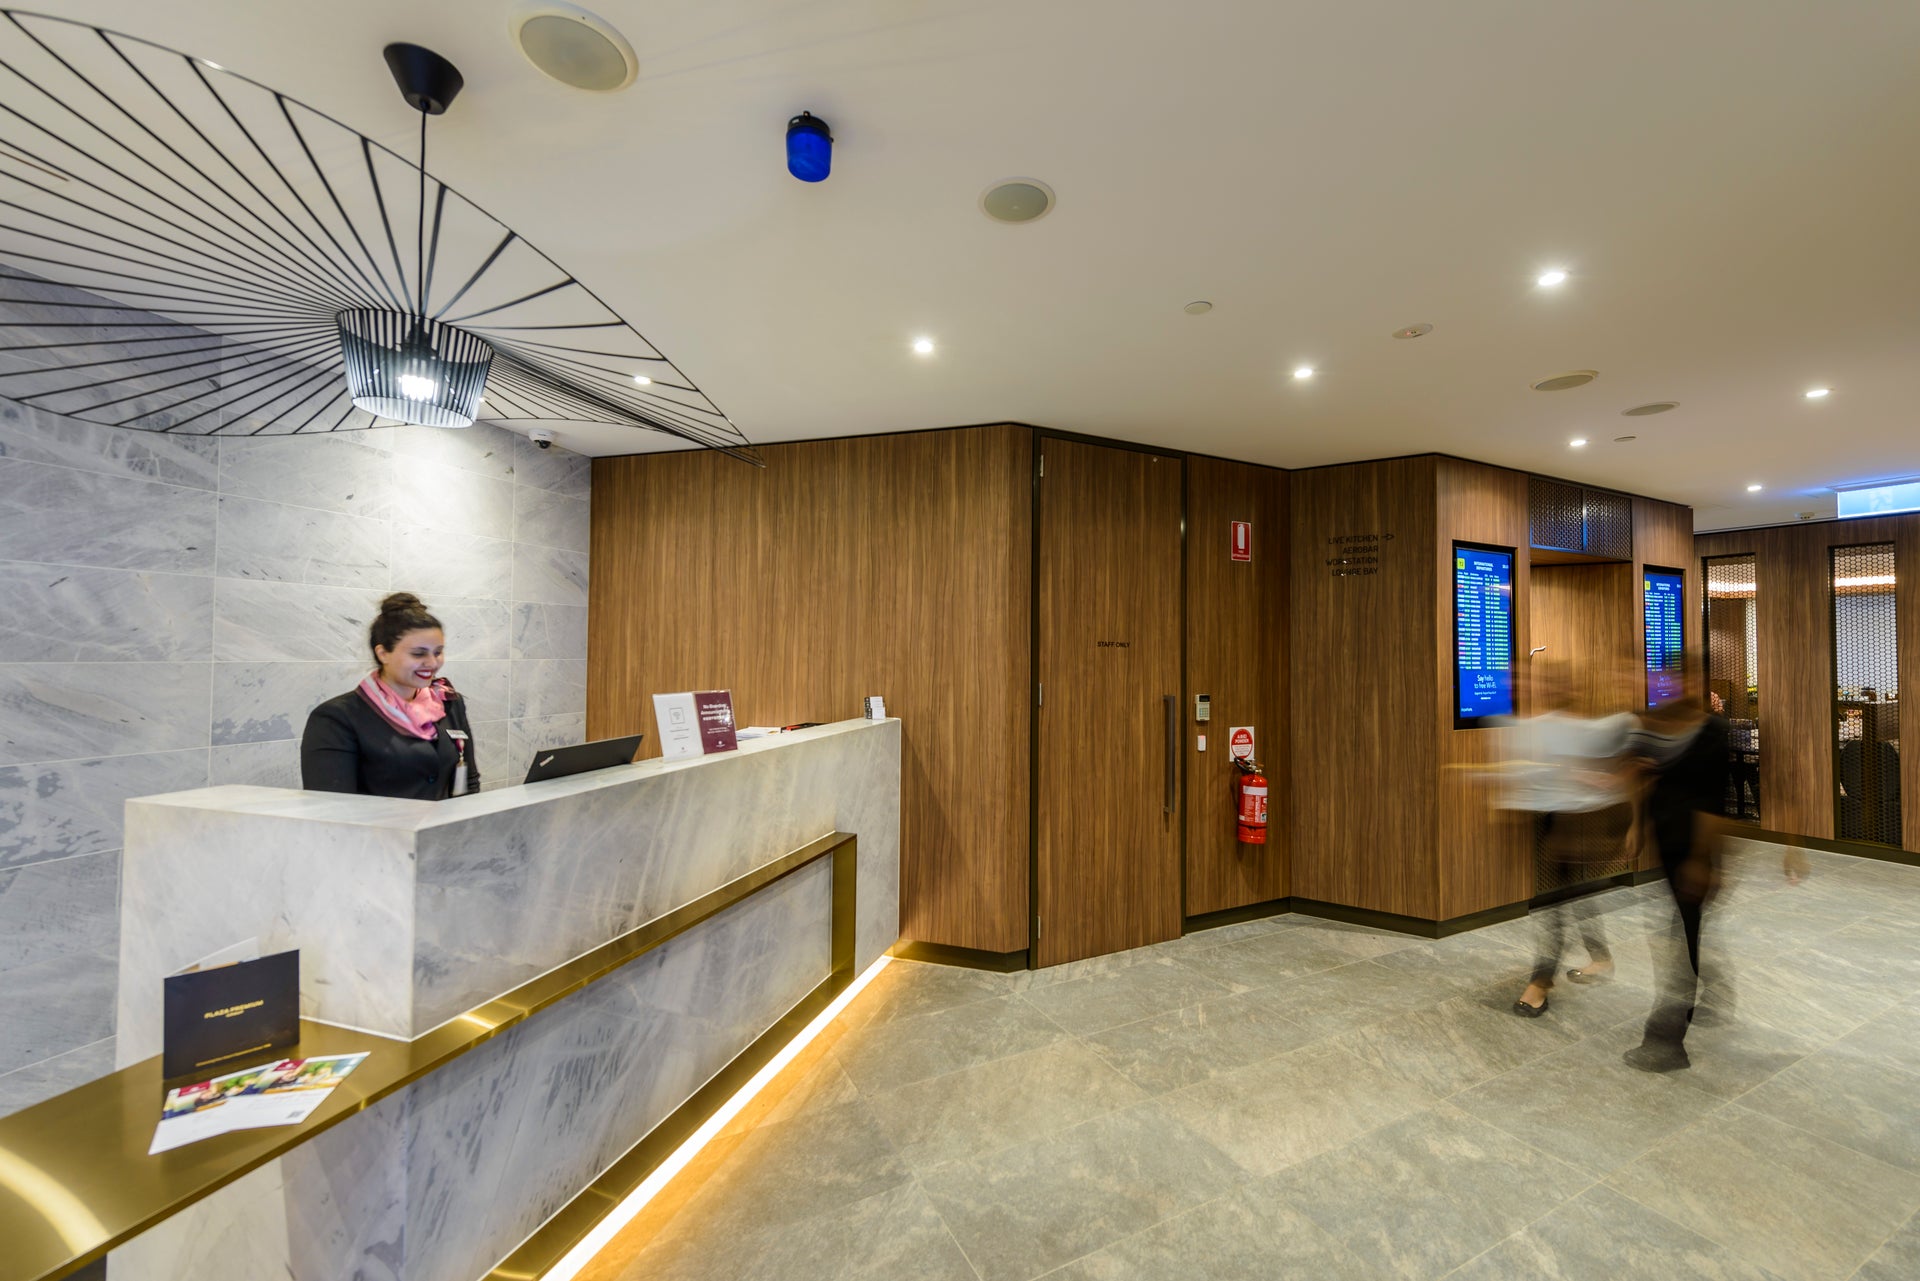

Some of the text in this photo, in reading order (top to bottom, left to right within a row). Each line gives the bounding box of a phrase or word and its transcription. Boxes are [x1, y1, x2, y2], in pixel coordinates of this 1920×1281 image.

[1346, 534, 1379, 544] KITCHEN
[1343, 545, 1379, 554] AEROBAR
[1363, 567, 1378, 575] BAY
